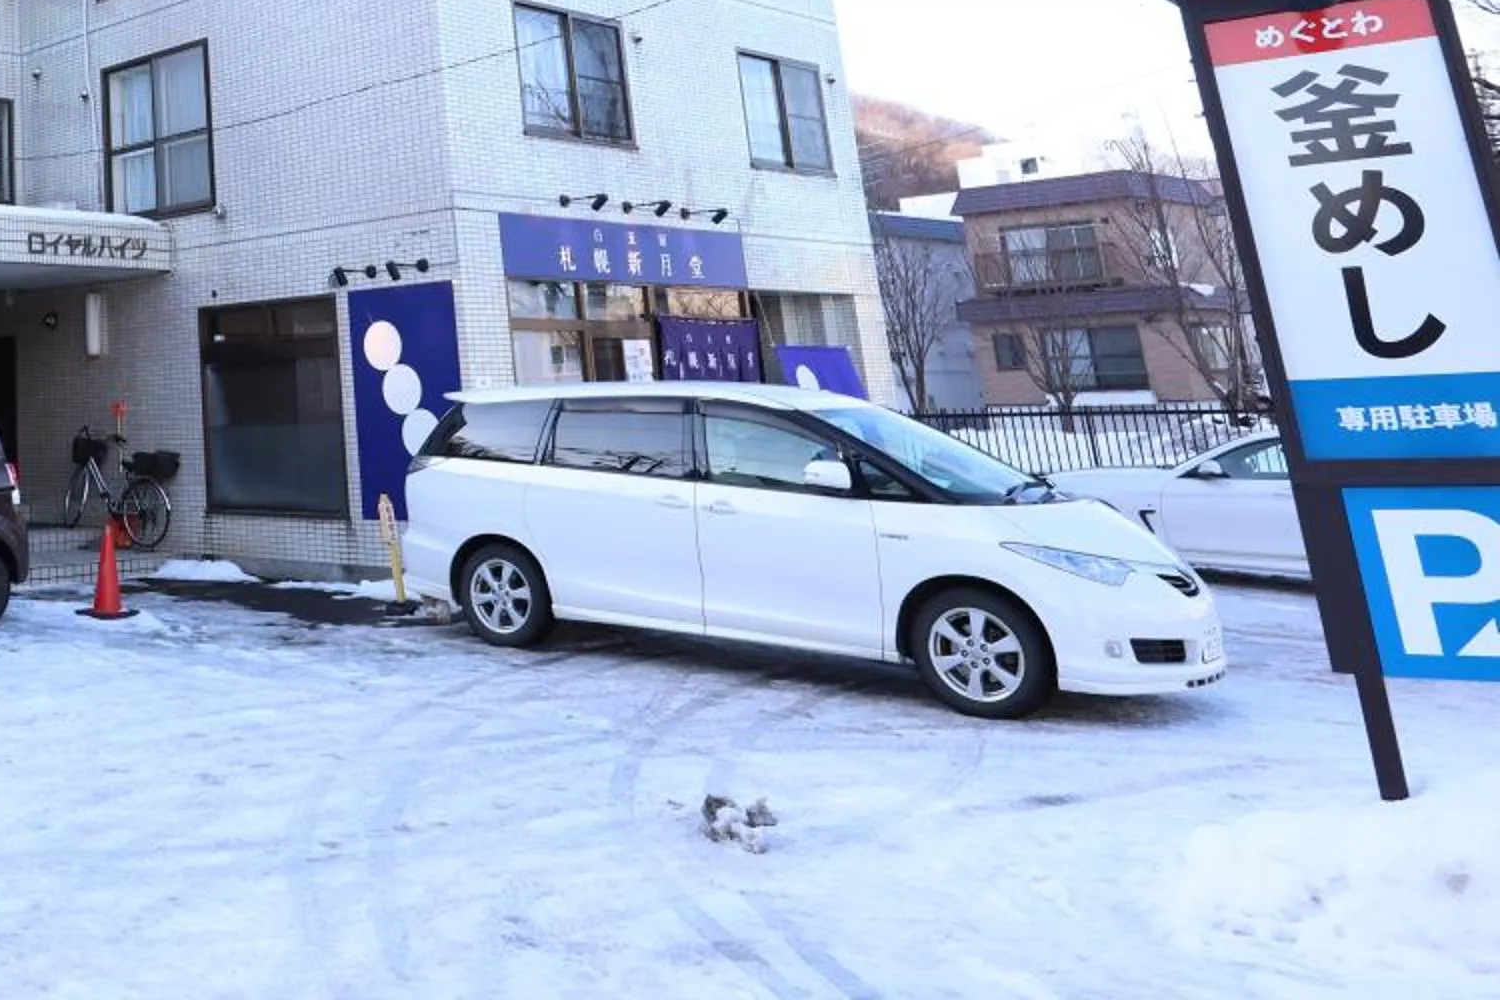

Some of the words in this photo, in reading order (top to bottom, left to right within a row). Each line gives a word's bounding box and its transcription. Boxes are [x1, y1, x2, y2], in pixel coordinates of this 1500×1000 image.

[1255, 9, 1383, 48] めぐとわ
[1270, 63, 1447, 359] 釜めし
[27, 231, 147, 260] ロイヤルハイツ
[559, 244, 706, 279] 札幌新月堂
[1336, 401, 1498, 431] 専用駐車場
[1371, 508, 1500, 656] P
